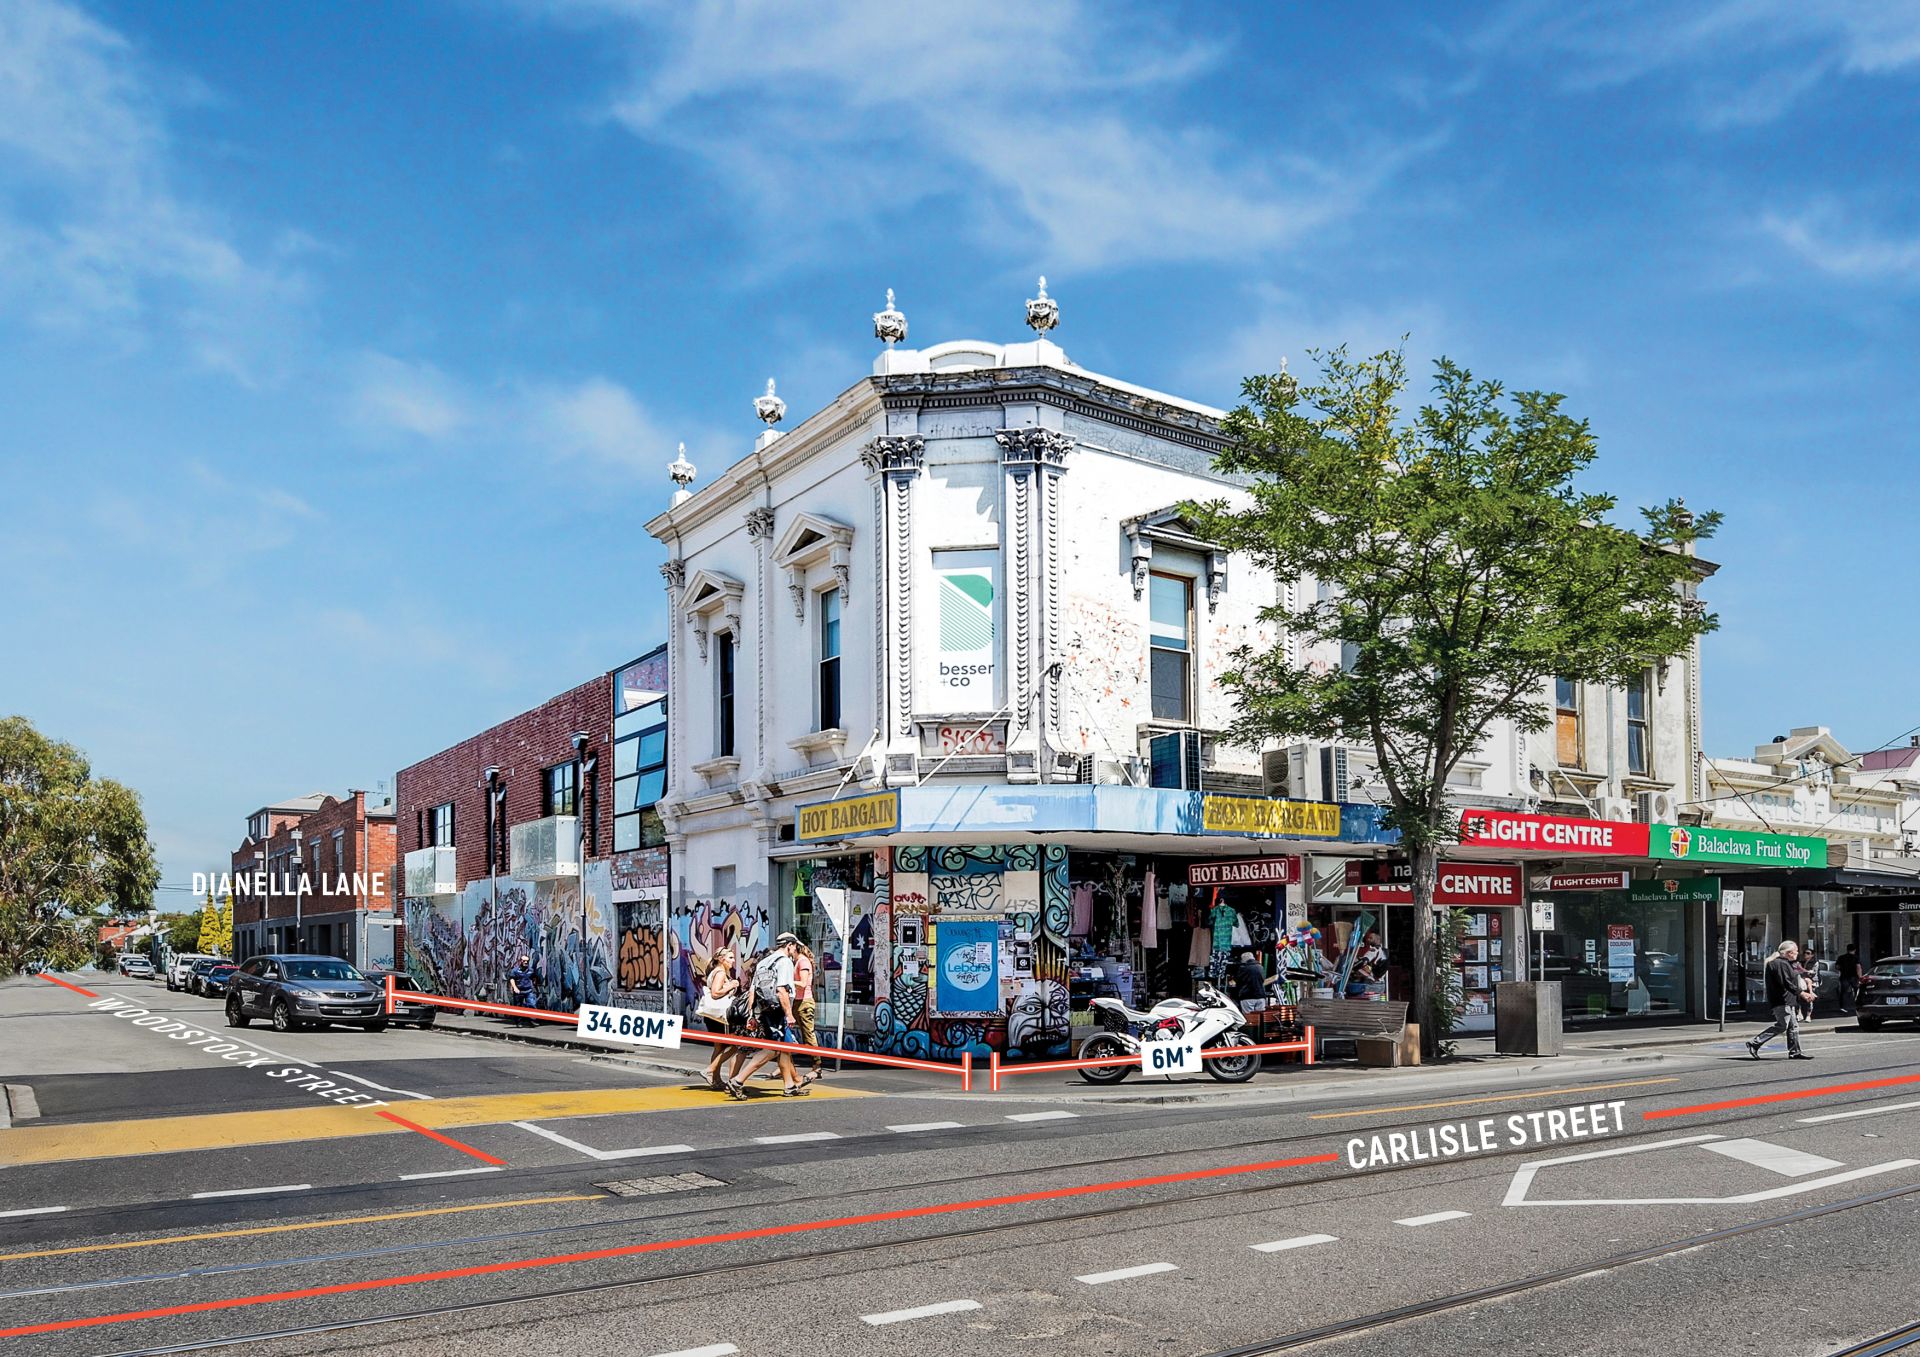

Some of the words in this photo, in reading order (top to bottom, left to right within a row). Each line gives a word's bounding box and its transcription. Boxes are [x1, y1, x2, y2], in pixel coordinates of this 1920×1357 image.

[940, 661, 995, 676] besser
[802, 809, 828, 834] HOT
[831, 799, 894, 830] BARGAIN
[1208, 801, 1248, 826] HOT
[1253, 803, 1337, 831] BARGAIN
[1732, 792, 1825, 825] CARLISLE
[1838, 802, 1882, 832] HALL
[1468, 817, 1540, 842] FLIGHT
[1542, 823, 1613, 847] CENTRE
[1698, 835, 1751, 855] Balaclava
[1755, 840, 1781, 858] Fruit
[1785, 842, 1811, 864] Shop
[1191, 866, 1219, 883] HOT
[1222, 862, 1286, 881] BARGAIN
[1393, 864, 1413, 877] na
[1441, 875, 1512, 895] CENTRE
[1553, 877, 1583, 887] FLIGHT
[1584, 876, 1619, 886] CENTRE
[1632, 893, 1667, 901] Balaclava
[1670, 892, 1689, 900] Fruit
[1692, 891, 1713, 901] Shop
[1611, 930, 1630, 939] SALE
